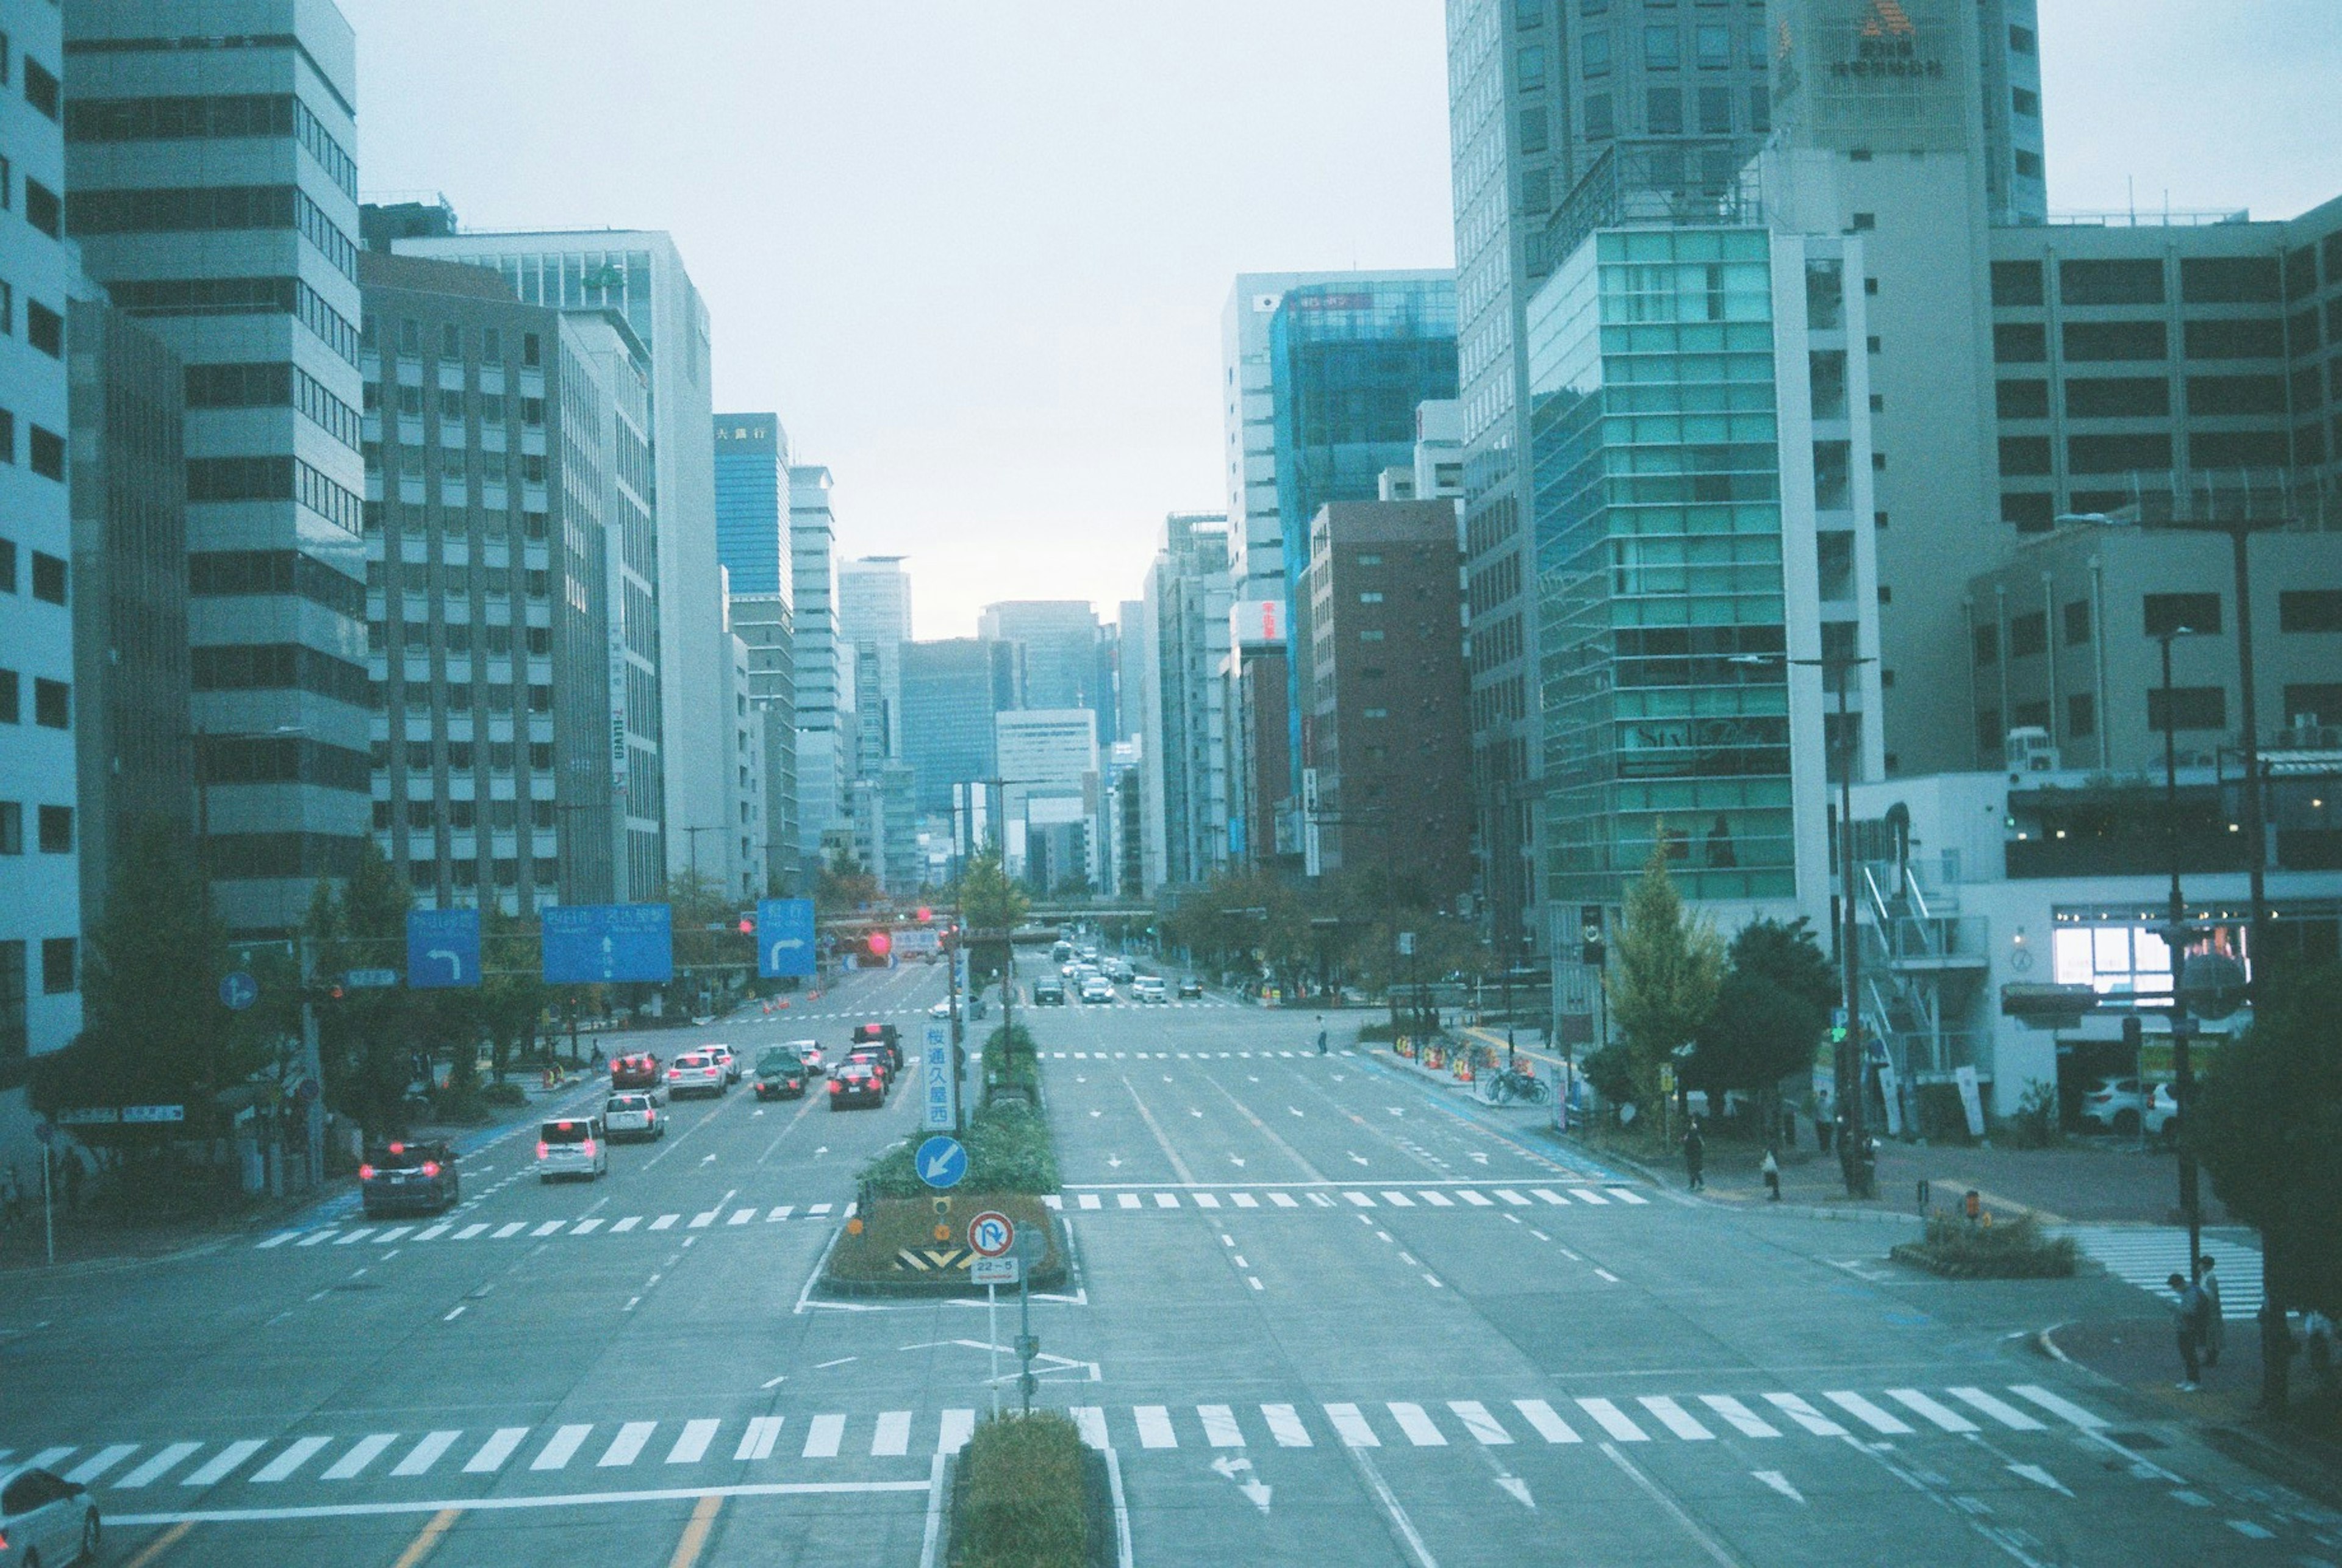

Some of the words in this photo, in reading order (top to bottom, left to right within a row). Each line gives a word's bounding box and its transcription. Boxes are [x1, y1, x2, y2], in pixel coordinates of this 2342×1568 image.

[926, 1028, 948, 1123] 桜通久屋西
